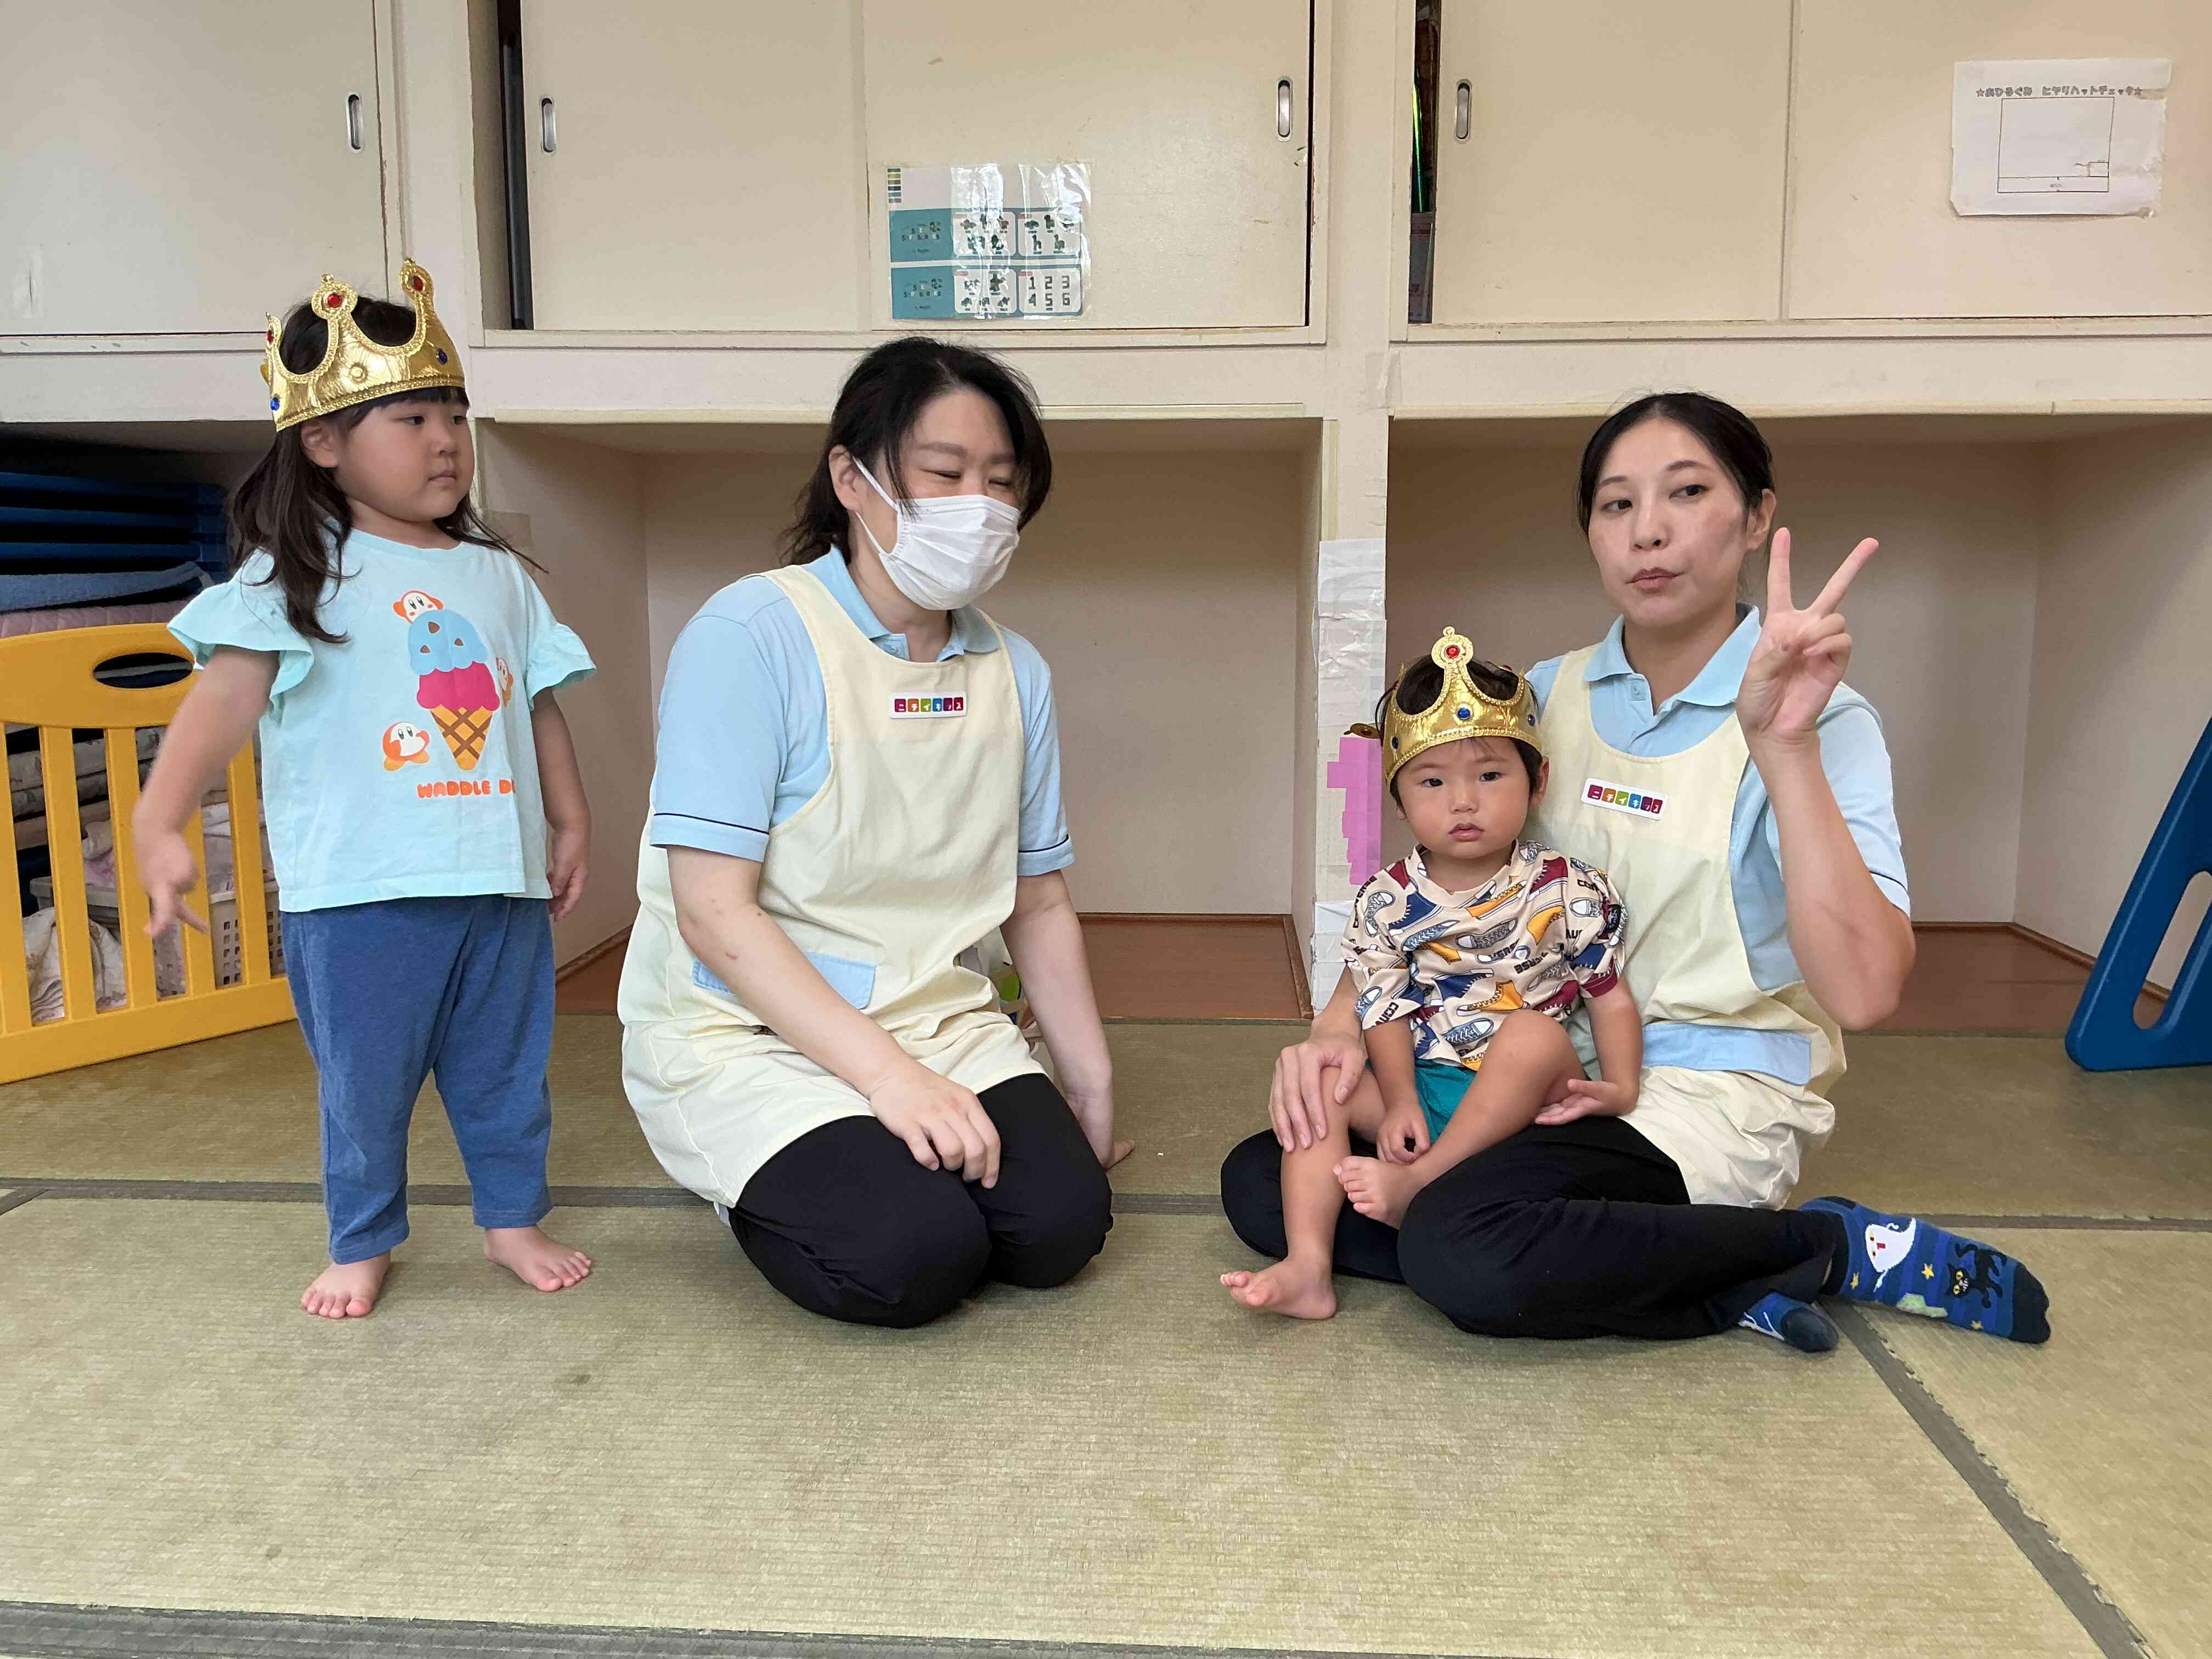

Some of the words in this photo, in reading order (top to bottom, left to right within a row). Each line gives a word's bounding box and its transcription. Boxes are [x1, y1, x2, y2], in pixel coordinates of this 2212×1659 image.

[1029, 276, 1036, 290] 1
[1045, 276, 1052, 290] 2
[1062, 275, 1070, 289] 3
[1028, 293, 1036, 307] 4
[1045, 293, 1053, 307] 5
[1062, 292, 1070, 306] 6
[417, 780, 491, 798] WADDLE
